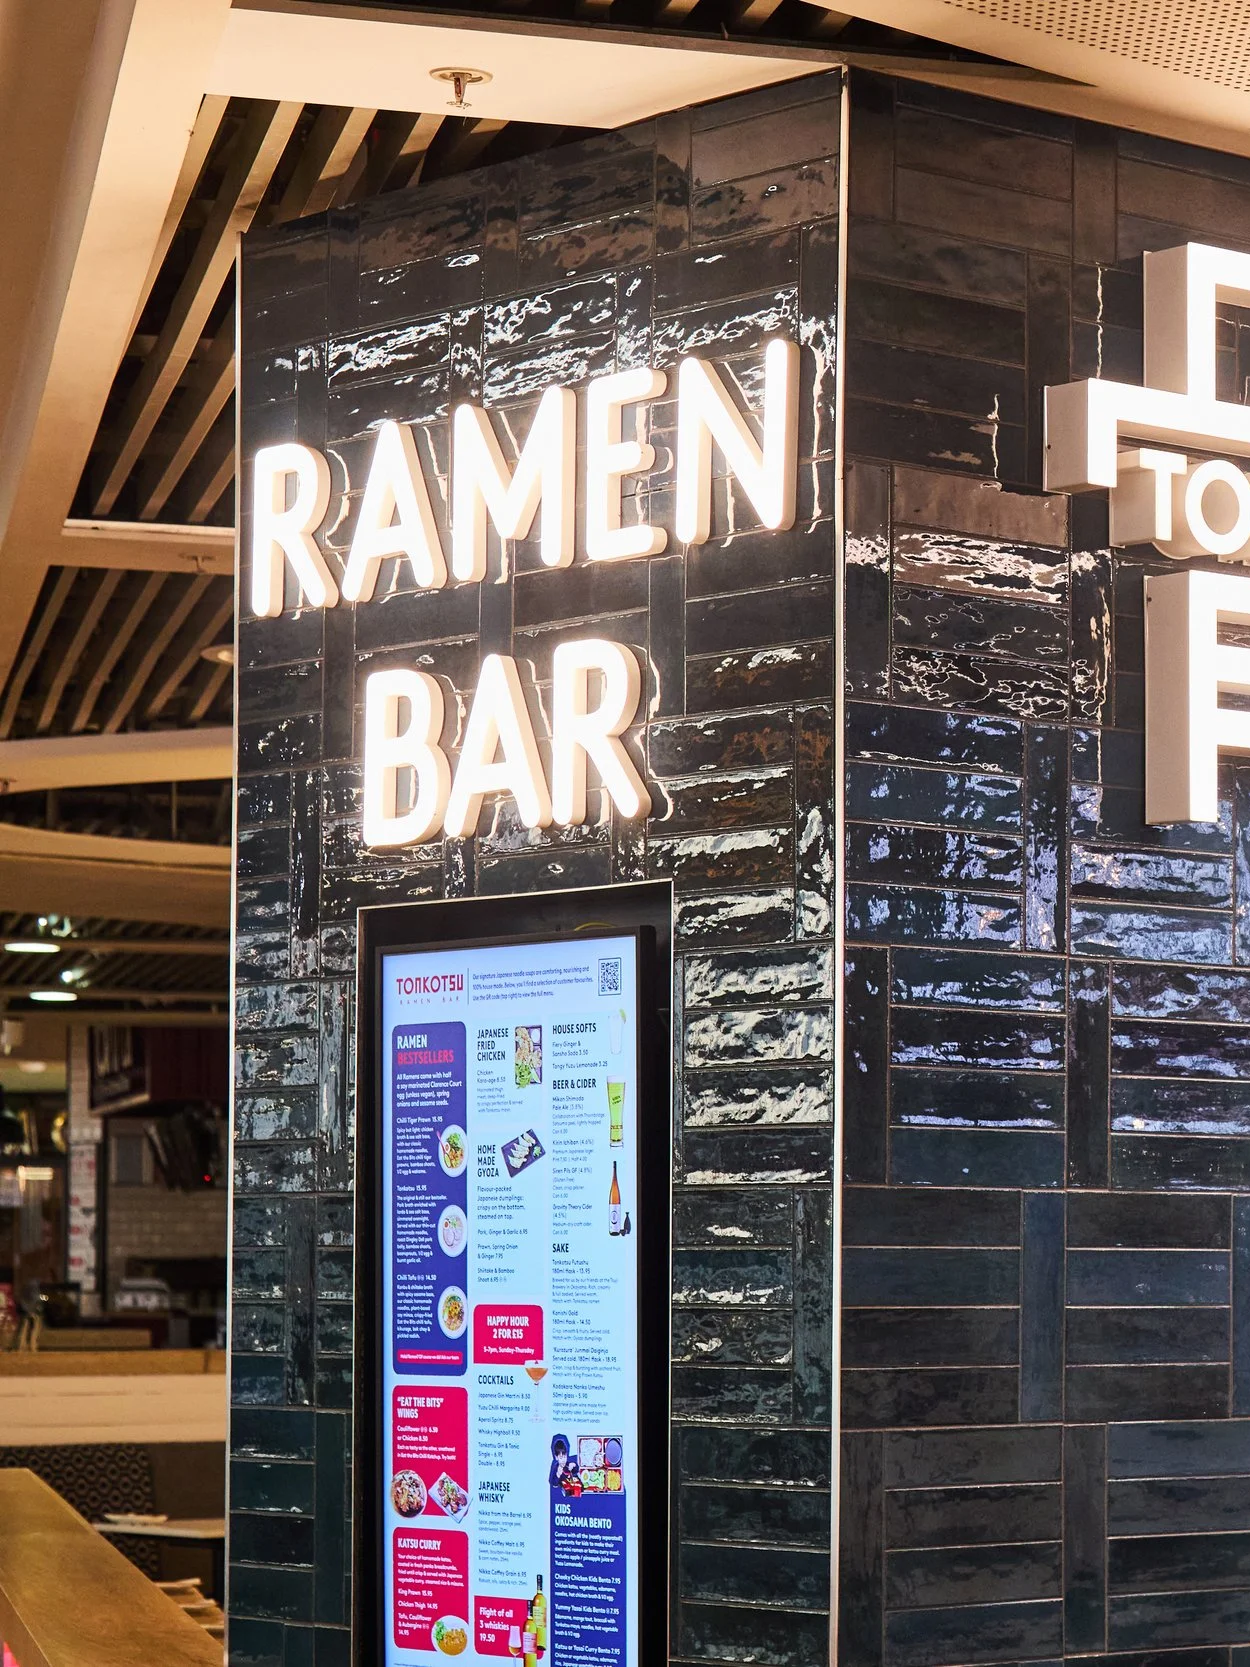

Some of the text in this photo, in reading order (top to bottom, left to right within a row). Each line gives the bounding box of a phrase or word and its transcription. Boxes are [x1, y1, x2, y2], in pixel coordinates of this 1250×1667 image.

[251, 338, 800, 619] RAMEN
[362, 638, 652, 848] BAR
[396, 974, 464, 995] TONKOTSU
[443, 995, 460, 1003] BAR
[477, 1028, 509, 1039] JAPANESE
[552, 1022, 597, 1035] HOUSE SOFTS
[397, 1034, 427, 1049] RAMEN
[477, 1040, 496, 1050] FRIED
[563, 1040, 577, 1048] Ginger
[397, 1049, 455, 1065] BESTSELLERS
[477, 1051, 506, 1062] CHICKEN
[552, 1078, 597, 1090] BEER & CIDER
[436, 1090, 450, 1098] spring
[407, 1117, 417, 1125] Tiger
[477, 1145, 496, 1154] HOME
[477, 1156, 496, 1166] MADE
[477, 1168, 499, 1178] GYOZA
[477, 1185, 512, 1193] Flavour-packed
[552, 1243, 569, 1253] SAKE
[487, 1315, 529, 1327] HAPPY HOUR
[493, 1328, 524, 1339] 2 FOR £15
[478, 1375, 514, 1385] COCKTAILS
[413, 1396, 425, 1407] THE
[397, 1408, 418, 1419] WINGS
[397, 1425, 420, 1433] Cauliflower
[479, 1481, 510, 1492] JAPANESE
[479, 1493, 505, 1503] WHISKY
[555, 1503, 571, 1515] KIDS
[555, 1515, 612, 1529] OKOSAMA BENTO
[398, 1538, 441, 1551] KATSU CURRY
[570, 1574, 588, 1582] Chicken
[598, 1576, 611, 1584] Bento
[398, 1588, 407, 1596] King
[408, 1588, 421, 1596] Prawn
[398, 1600, 414, 1608] Chicken
[414, 1601, 426, 1610] Thigh
[583, 1605, 592, 1613] Kids
[409, 1613, 432, 1622] Cauliflower
[480, 1606, 513, 1619] Flight of all
[402, 1622, 421, 1630] Aubergine
[480, 1620, 509, 1631] 3 whiskies
[480, 1633, 496, 1643] 19.50
[585, 1646, 597, 1654] Curry
